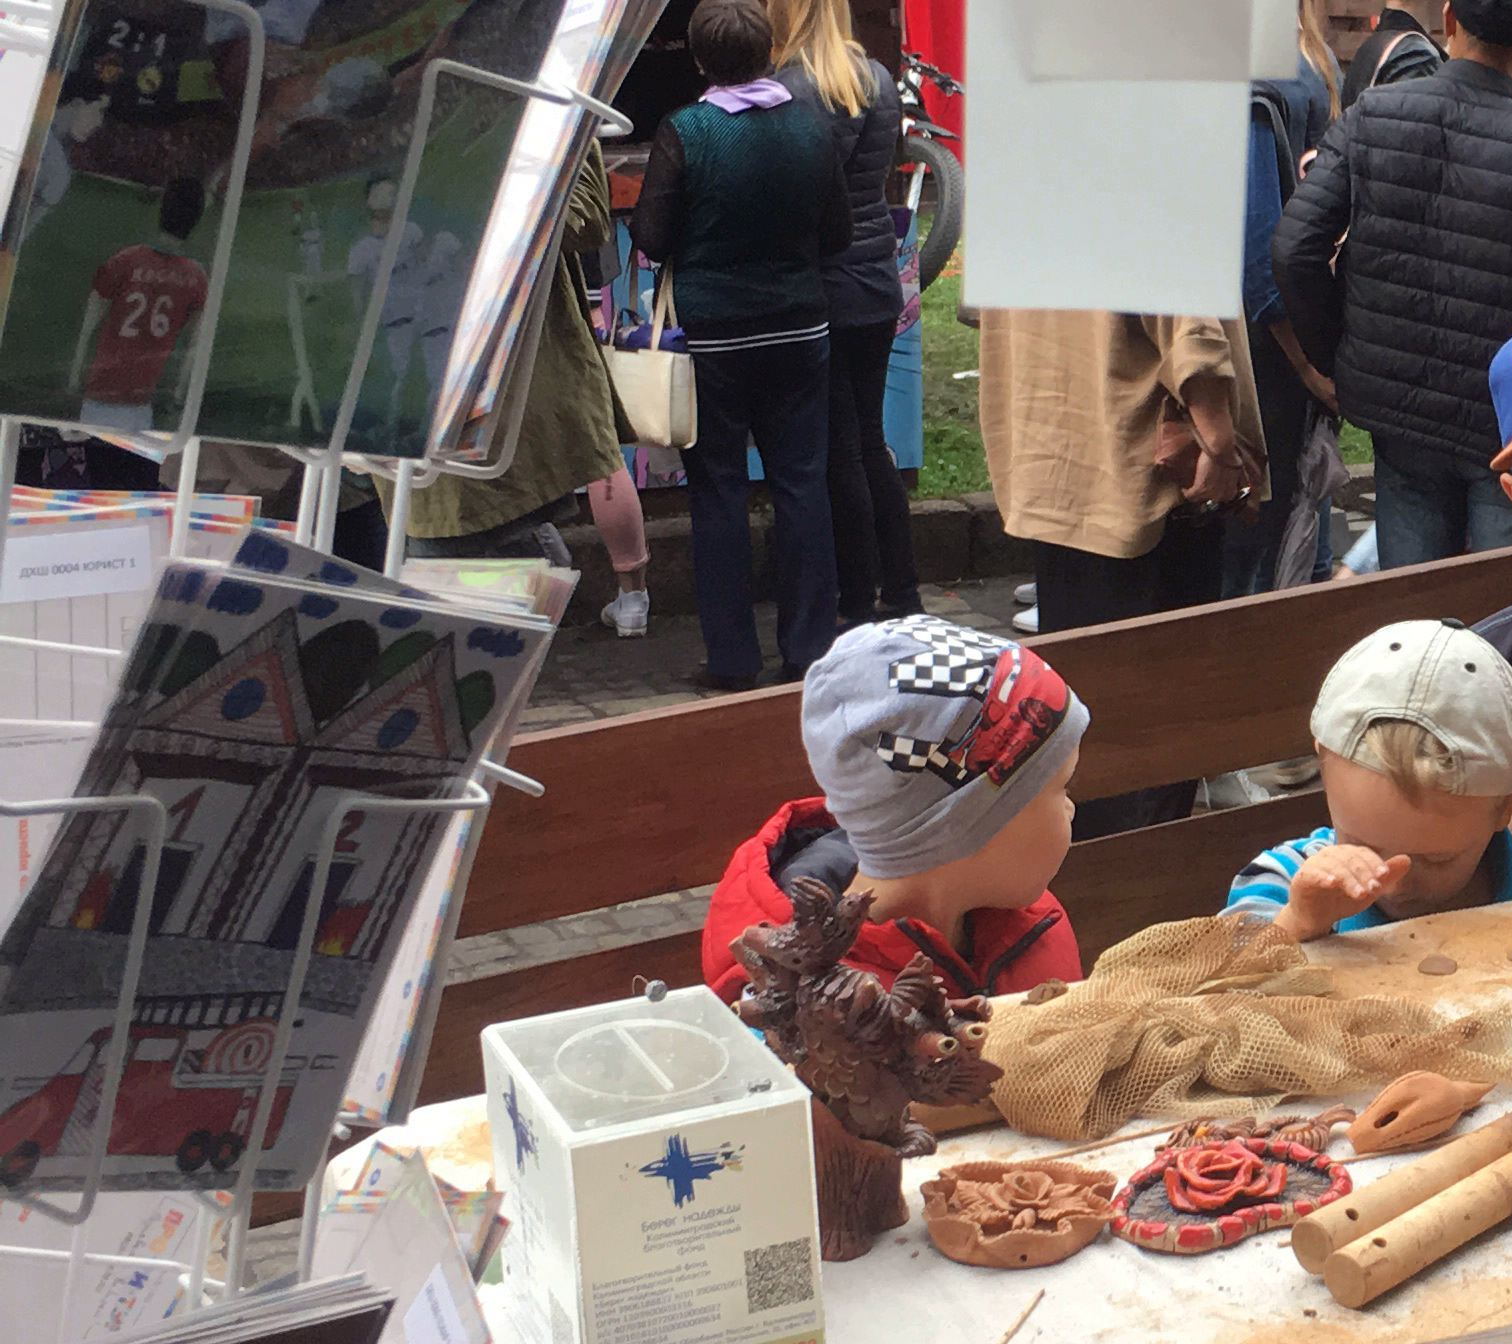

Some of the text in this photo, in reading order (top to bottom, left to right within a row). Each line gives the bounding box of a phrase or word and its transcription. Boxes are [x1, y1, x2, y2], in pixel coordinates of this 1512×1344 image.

[117, 291, 175, 338] 26
[641, 1201, 741, 1232] Берег надежды
